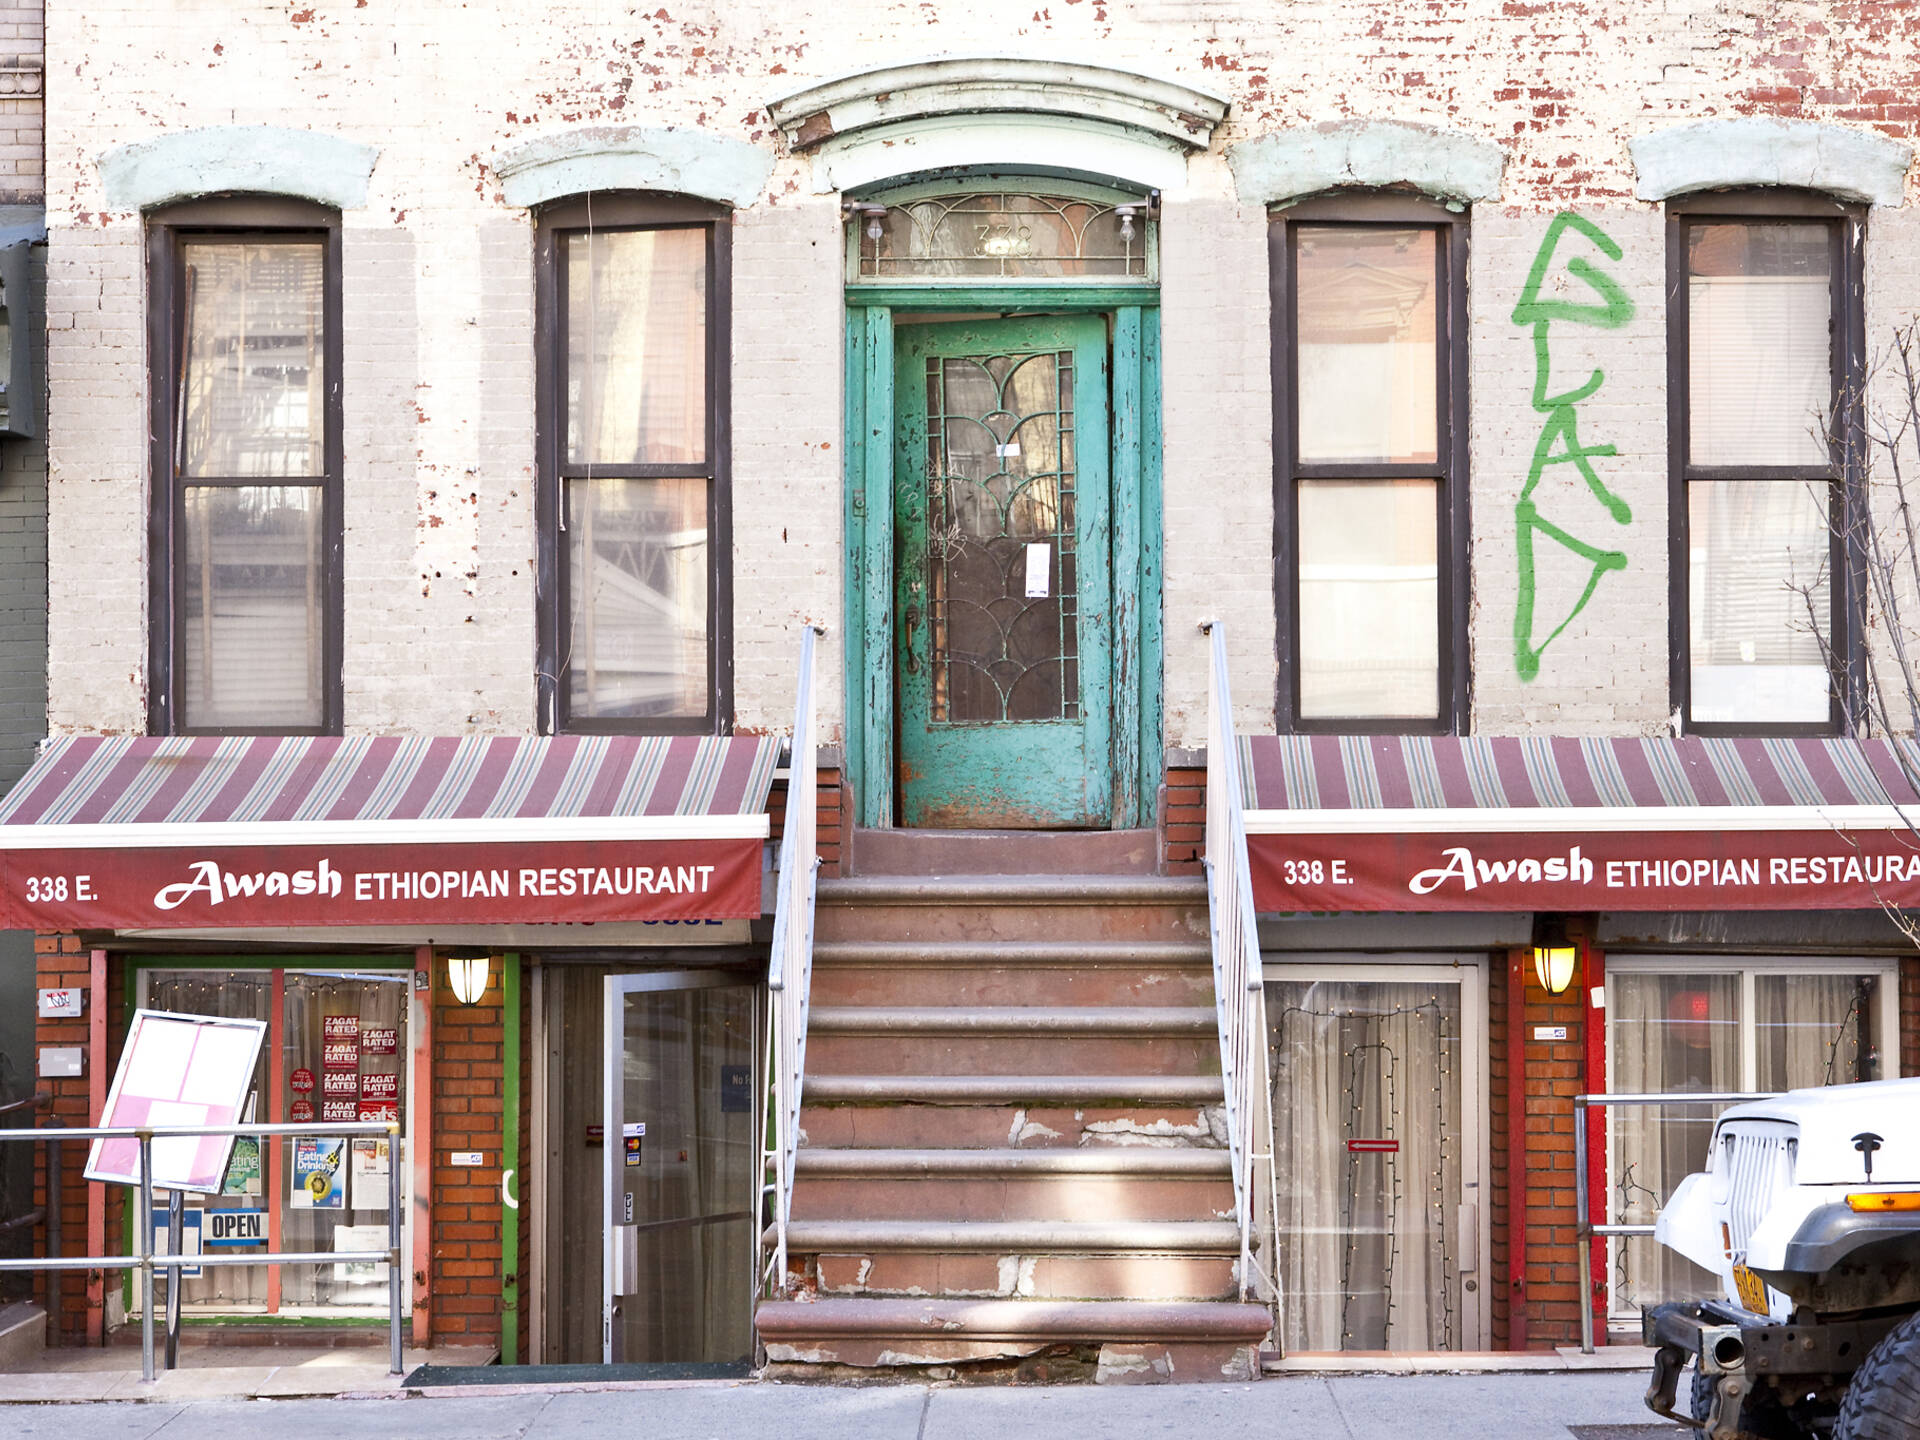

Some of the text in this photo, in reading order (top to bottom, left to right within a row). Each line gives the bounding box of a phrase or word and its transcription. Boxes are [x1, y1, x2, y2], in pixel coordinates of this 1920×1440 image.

[1283, 859, 1326, 885] 338
[1332, 859, 1354, 885] E.
[1408, 845, 1594, 895] Awash
[1605, 858, 1760, 888] ETHIOPIAN
[25, 858, 716, 911] 338 E. Awash ETHIOPIAN RESTAURANT
[325, 1017, 358, 1025] ZAGAT
[325, 1026, 358, 1034] RATED
[362, 1030, 395, 1039] ZAGAT
[362, 1039, 395, 1047] RATED
[325, 1045, 358, 1053] ZAGAT
[325, 1053, 358, 1061] RATED
[324, 1073, 357, 1082] ZAGAT
[363, 1076, 396, 1084] ZAGAT
[324, 1082, 357, 1090] RATED
[363, 1084, 396, 1092] RATED
[323, 1101, 356, 1110] ZAGAT
[323, 1110, 356, 1118] RATED
[359, 1106, 397, 1121] eats
[231, 1154, 259, 1168] ating
[212, 1215, 261, 1238] OPEN
